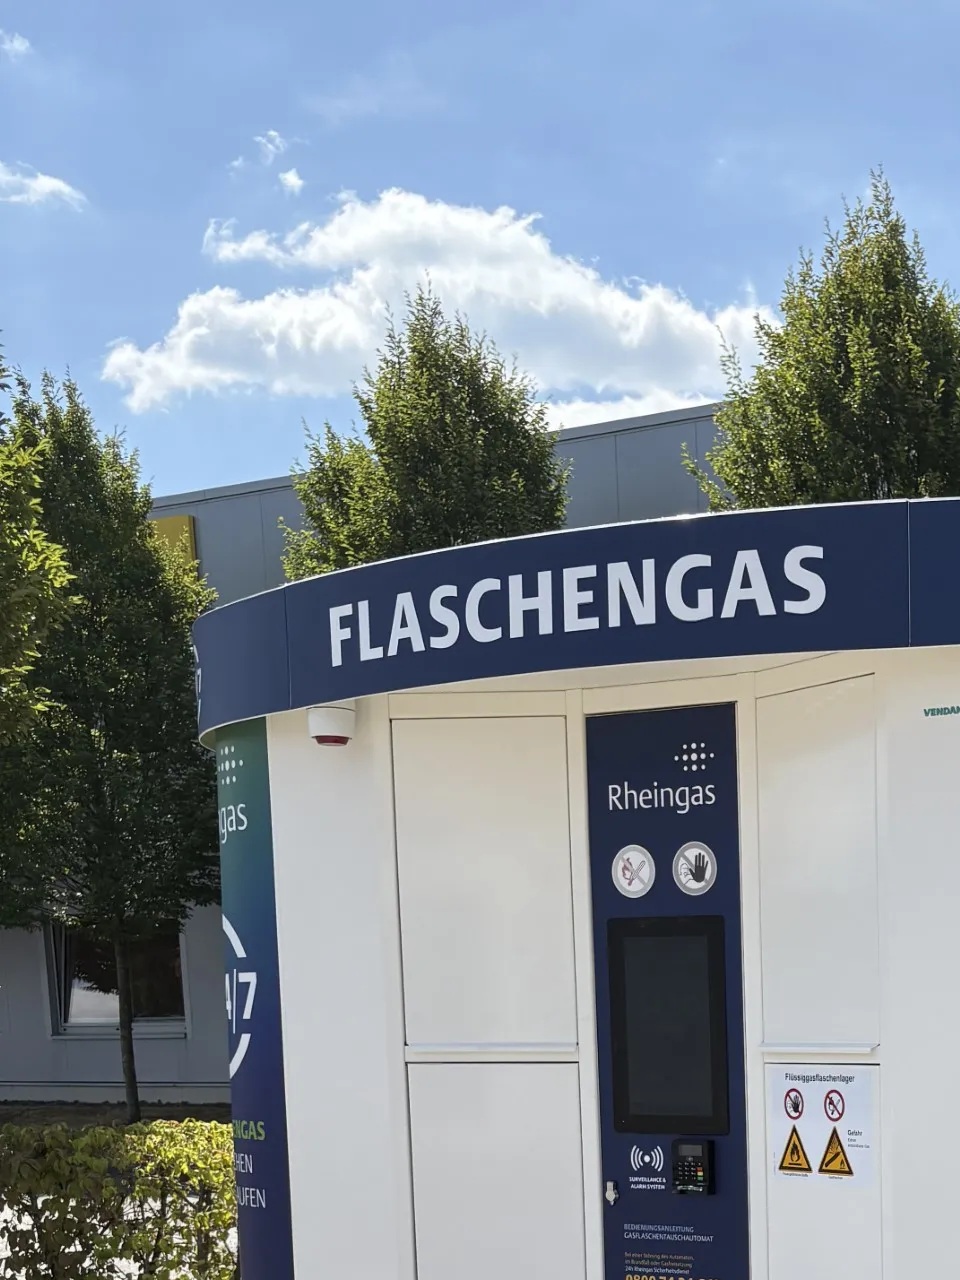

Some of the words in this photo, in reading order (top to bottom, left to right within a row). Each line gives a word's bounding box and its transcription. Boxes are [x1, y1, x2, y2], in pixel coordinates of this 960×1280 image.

[328, 544, 827, 668] FLASCHENGAS
[607, 781, 716, 815] Rheingas
[784, 1072, 856, 1085] Flüssiggasflaschenlager
[623, 1223, 695, 1233] BEDIENUNGSANLEITUNG
[623, 1231, 714, 1242] GASFLASCHENTAUSCHAUTOMAT
